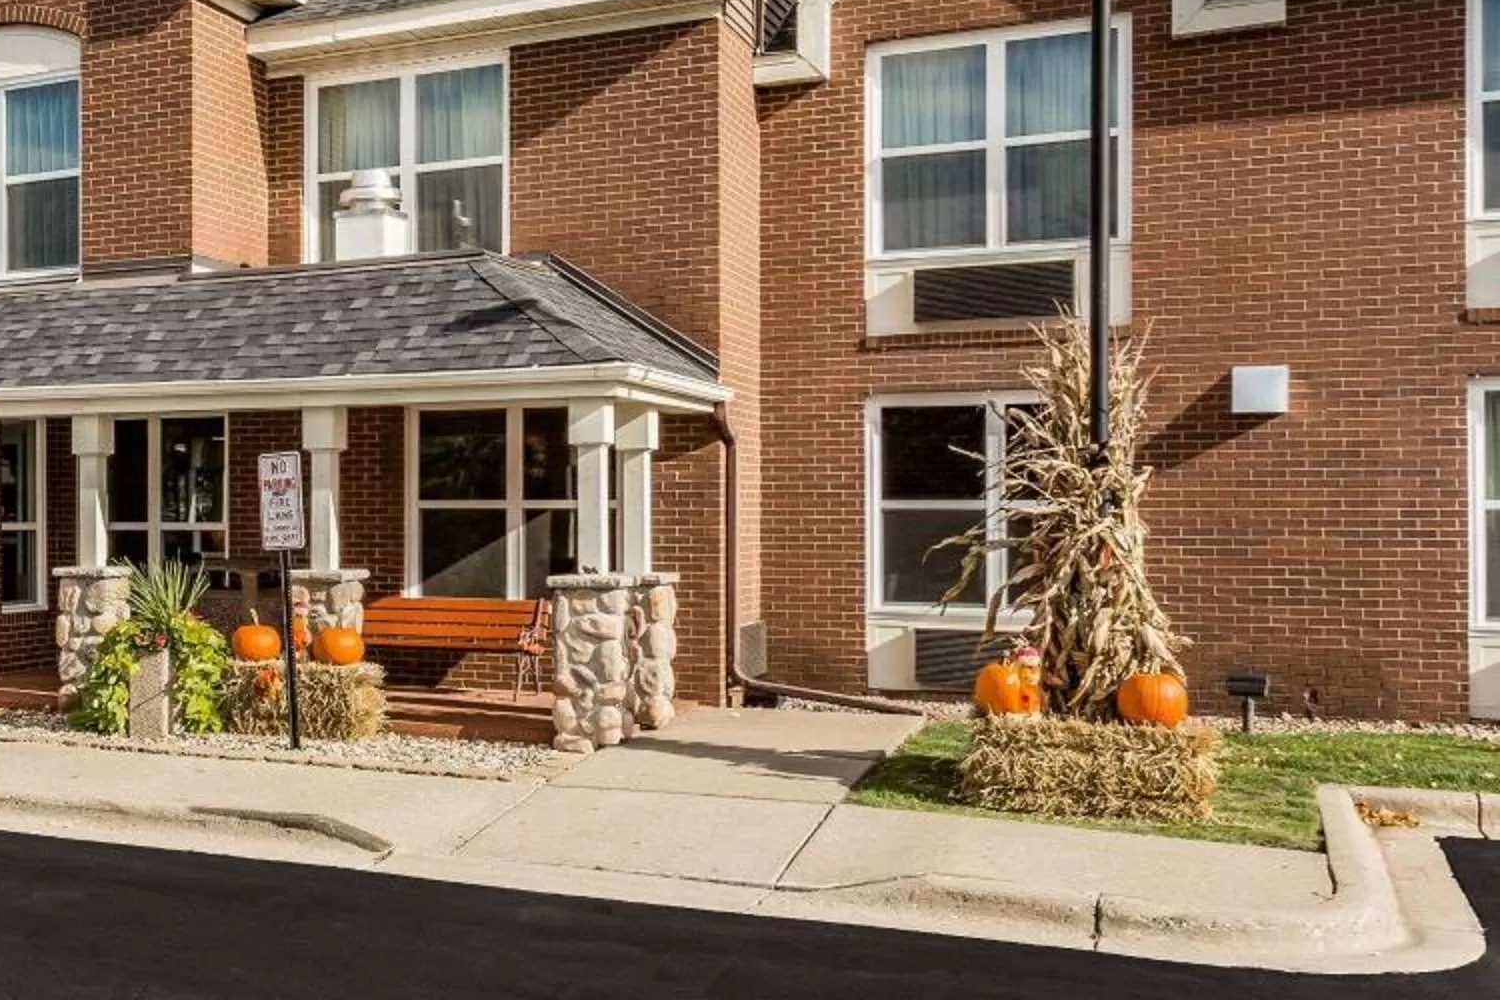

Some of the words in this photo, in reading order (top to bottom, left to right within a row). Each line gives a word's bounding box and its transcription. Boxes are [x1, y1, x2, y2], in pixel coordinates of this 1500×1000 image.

[271, 460, 287, 475] NO
[269, 497, 291, 509] FIRE
[268, 510, 294, 521] LANE
